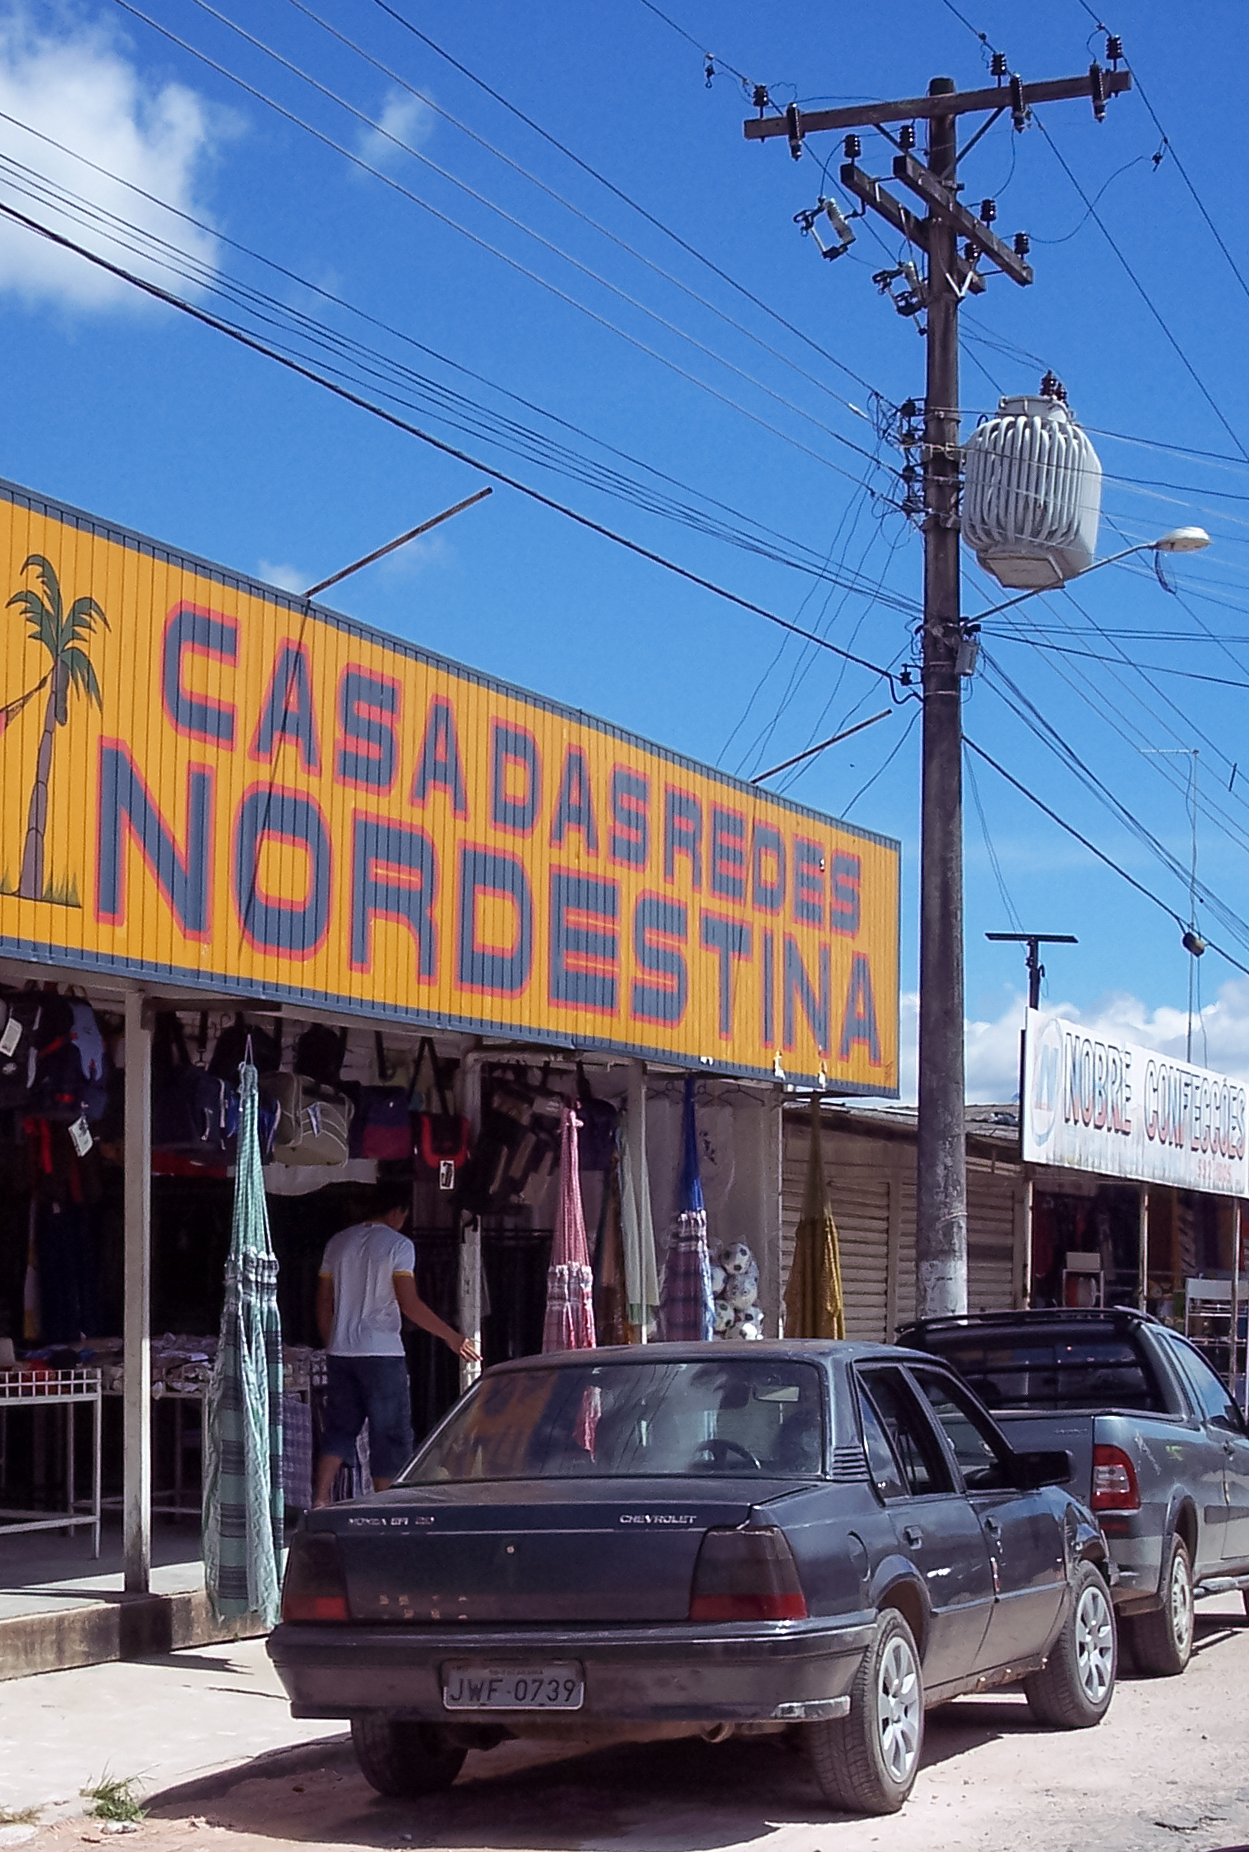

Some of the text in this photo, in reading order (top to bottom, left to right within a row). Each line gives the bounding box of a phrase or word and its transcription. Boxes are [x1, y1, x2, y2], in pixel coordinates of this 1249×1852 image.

[162, 600, 862, 938] CASA DAS REDES
[95, 735, 881, 1067] NORDESTINA
[1063, 1032, 1132, 1136] NOBRE
[619, 1514, 697, 1524] CHEVROLET
